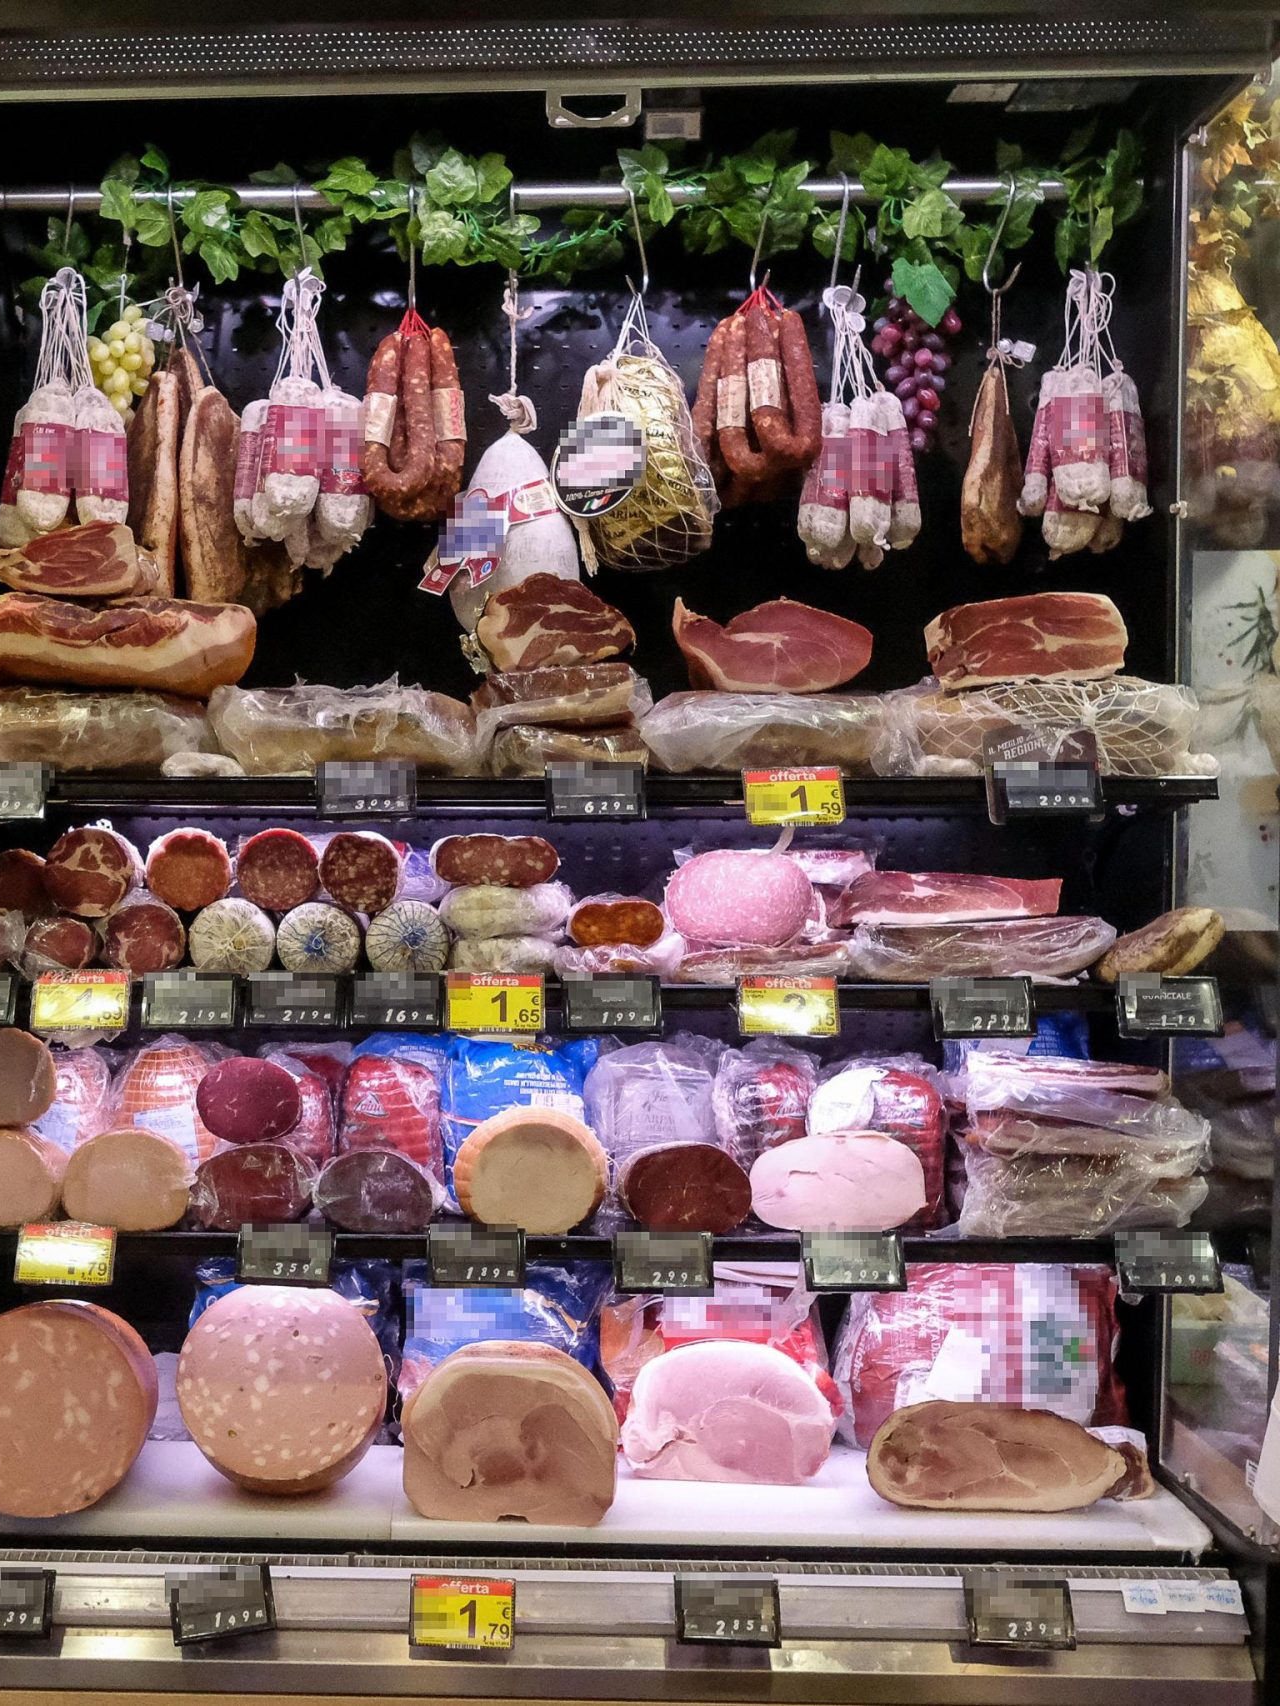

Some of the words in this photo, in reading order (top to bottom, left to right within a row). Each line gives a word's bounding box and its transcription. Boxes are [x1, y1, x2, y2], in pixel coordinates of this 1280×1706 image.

[1003, 736, 1047, 760] REGIONE
[769, 771, 817, 781] offerta
[472, 976, 520, 987] offerta
[764, 978, 812, 989] offerta
